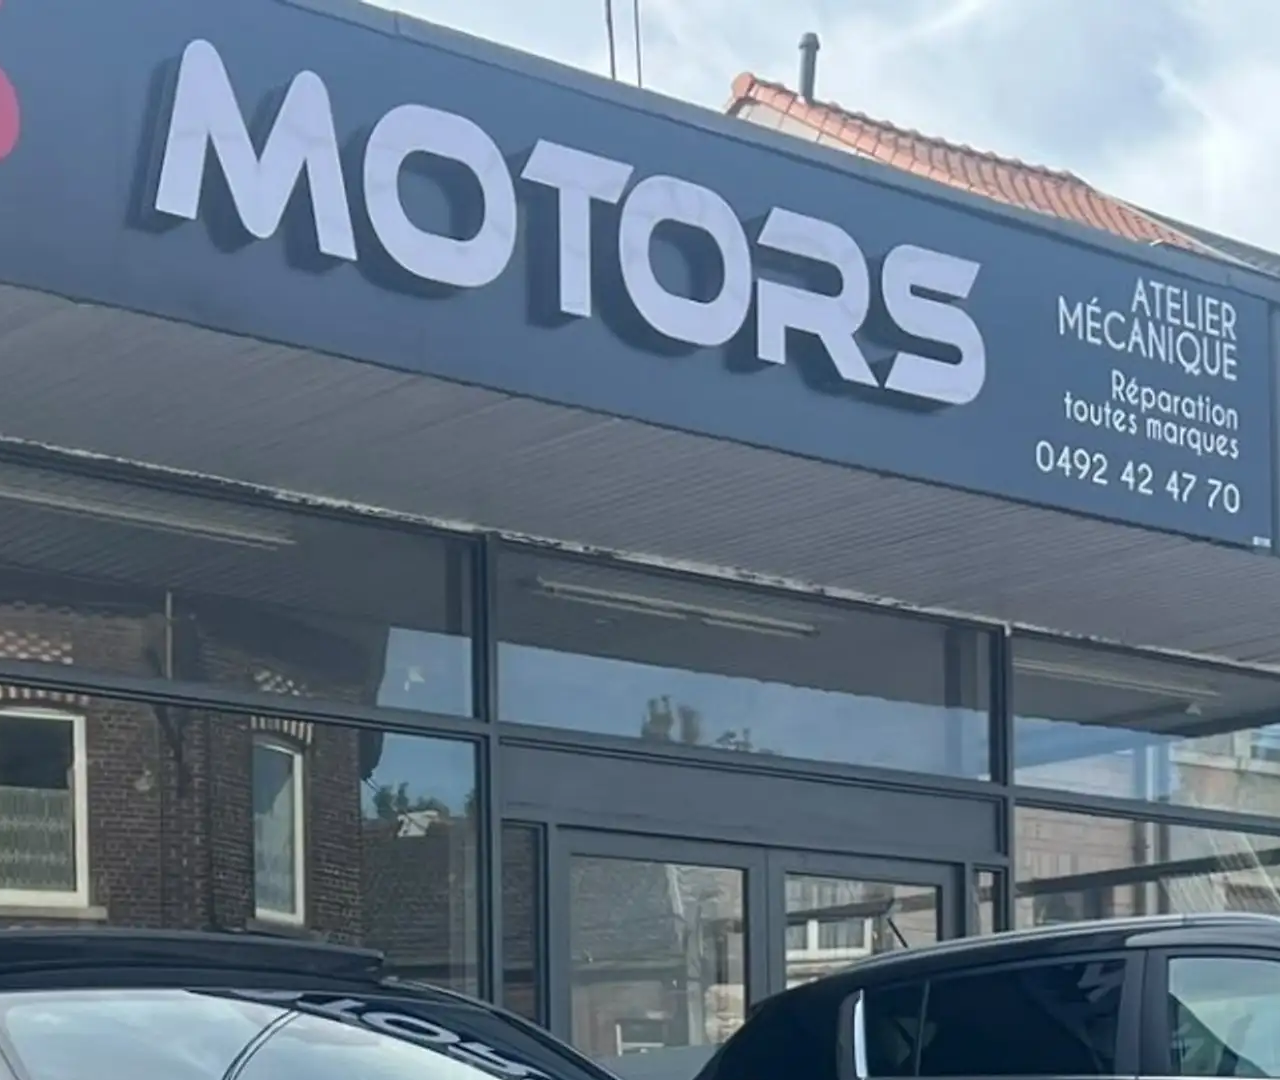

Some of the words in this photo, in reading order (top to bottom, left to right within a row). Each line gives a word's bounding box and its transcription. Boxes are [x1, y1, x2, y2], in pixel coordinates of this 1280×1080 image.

[154, 38, 987, 405] MOTORS
[1057, 294, 1238, 382] MÉCANIQUE
[1131, 277, 1237, 341] ATELIER
[1063, 391, 1138, 435] toutes
[1145, 416, 1240, 460] marques
[1111, 368, 1238, 430] Réparation
[1035, 440, 1109, 486] 0492
[1120, 460, 1154, 495] 42
[1166, 470, 1197, 503] 47
[1207, 478, 1241, 514] 70
